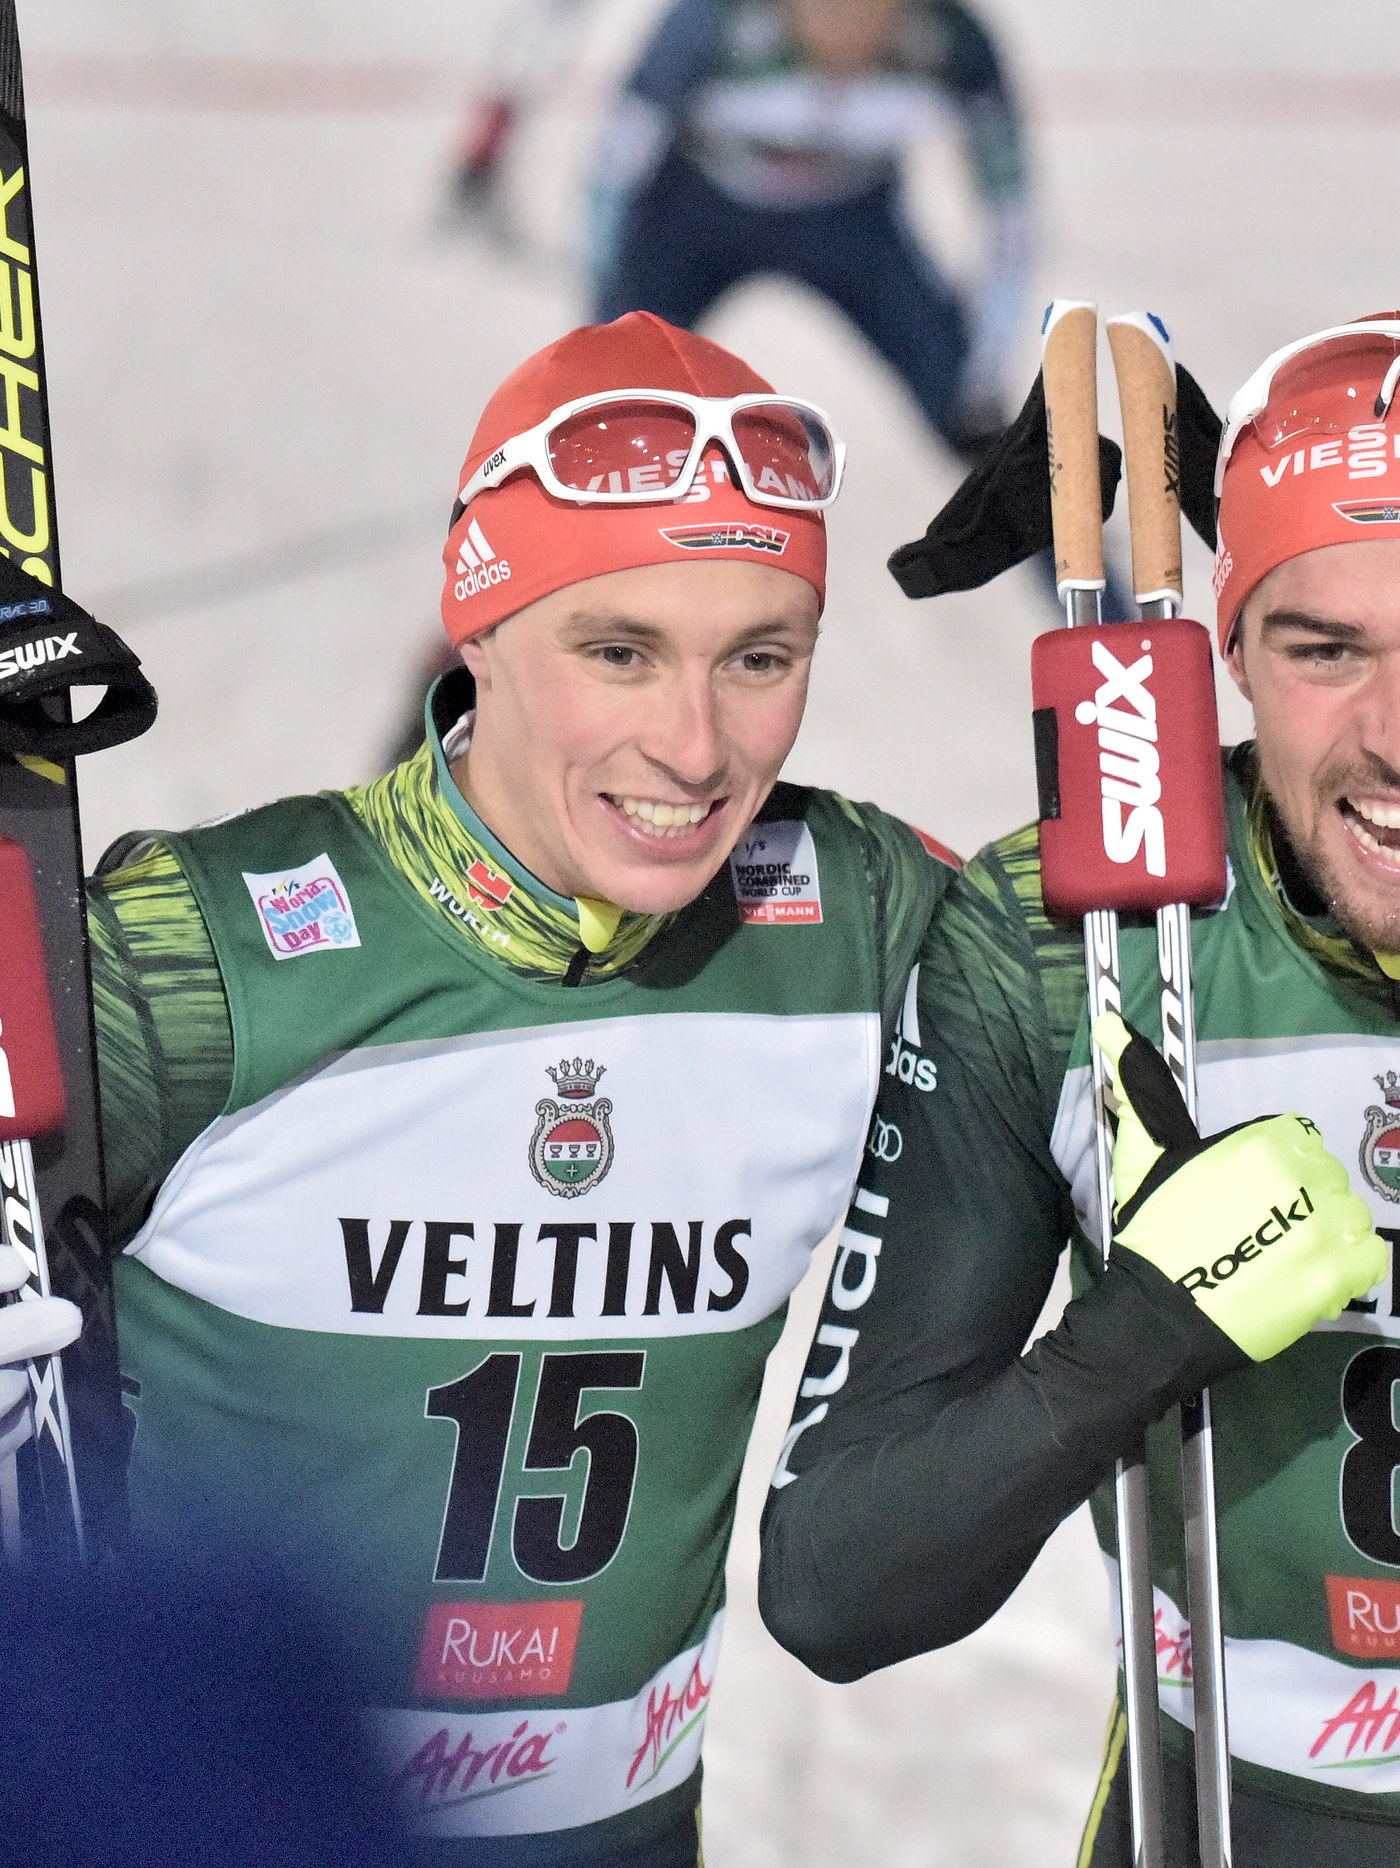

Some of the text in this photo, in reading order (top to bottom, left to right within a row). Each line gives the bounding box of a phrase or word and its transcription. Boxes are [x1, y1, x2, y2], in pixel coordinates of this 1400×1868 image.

[483, 449, 506, 477] uvex
[455, 560, 511, 601] adidas
[735, 863, 791, 876] NORDIC
[738, 875, 810, 887] COMBINED
[741, 886, 802, 898] WORLD CUP
[282, 922, 321, 949] Day
[337, 1217, 752, 1317] VELTINS
[424, 1351, 647, 1585] 15
[442, 1618, 559, 1668] RUKA!
[400, 1721, 558, 1801] Atria
